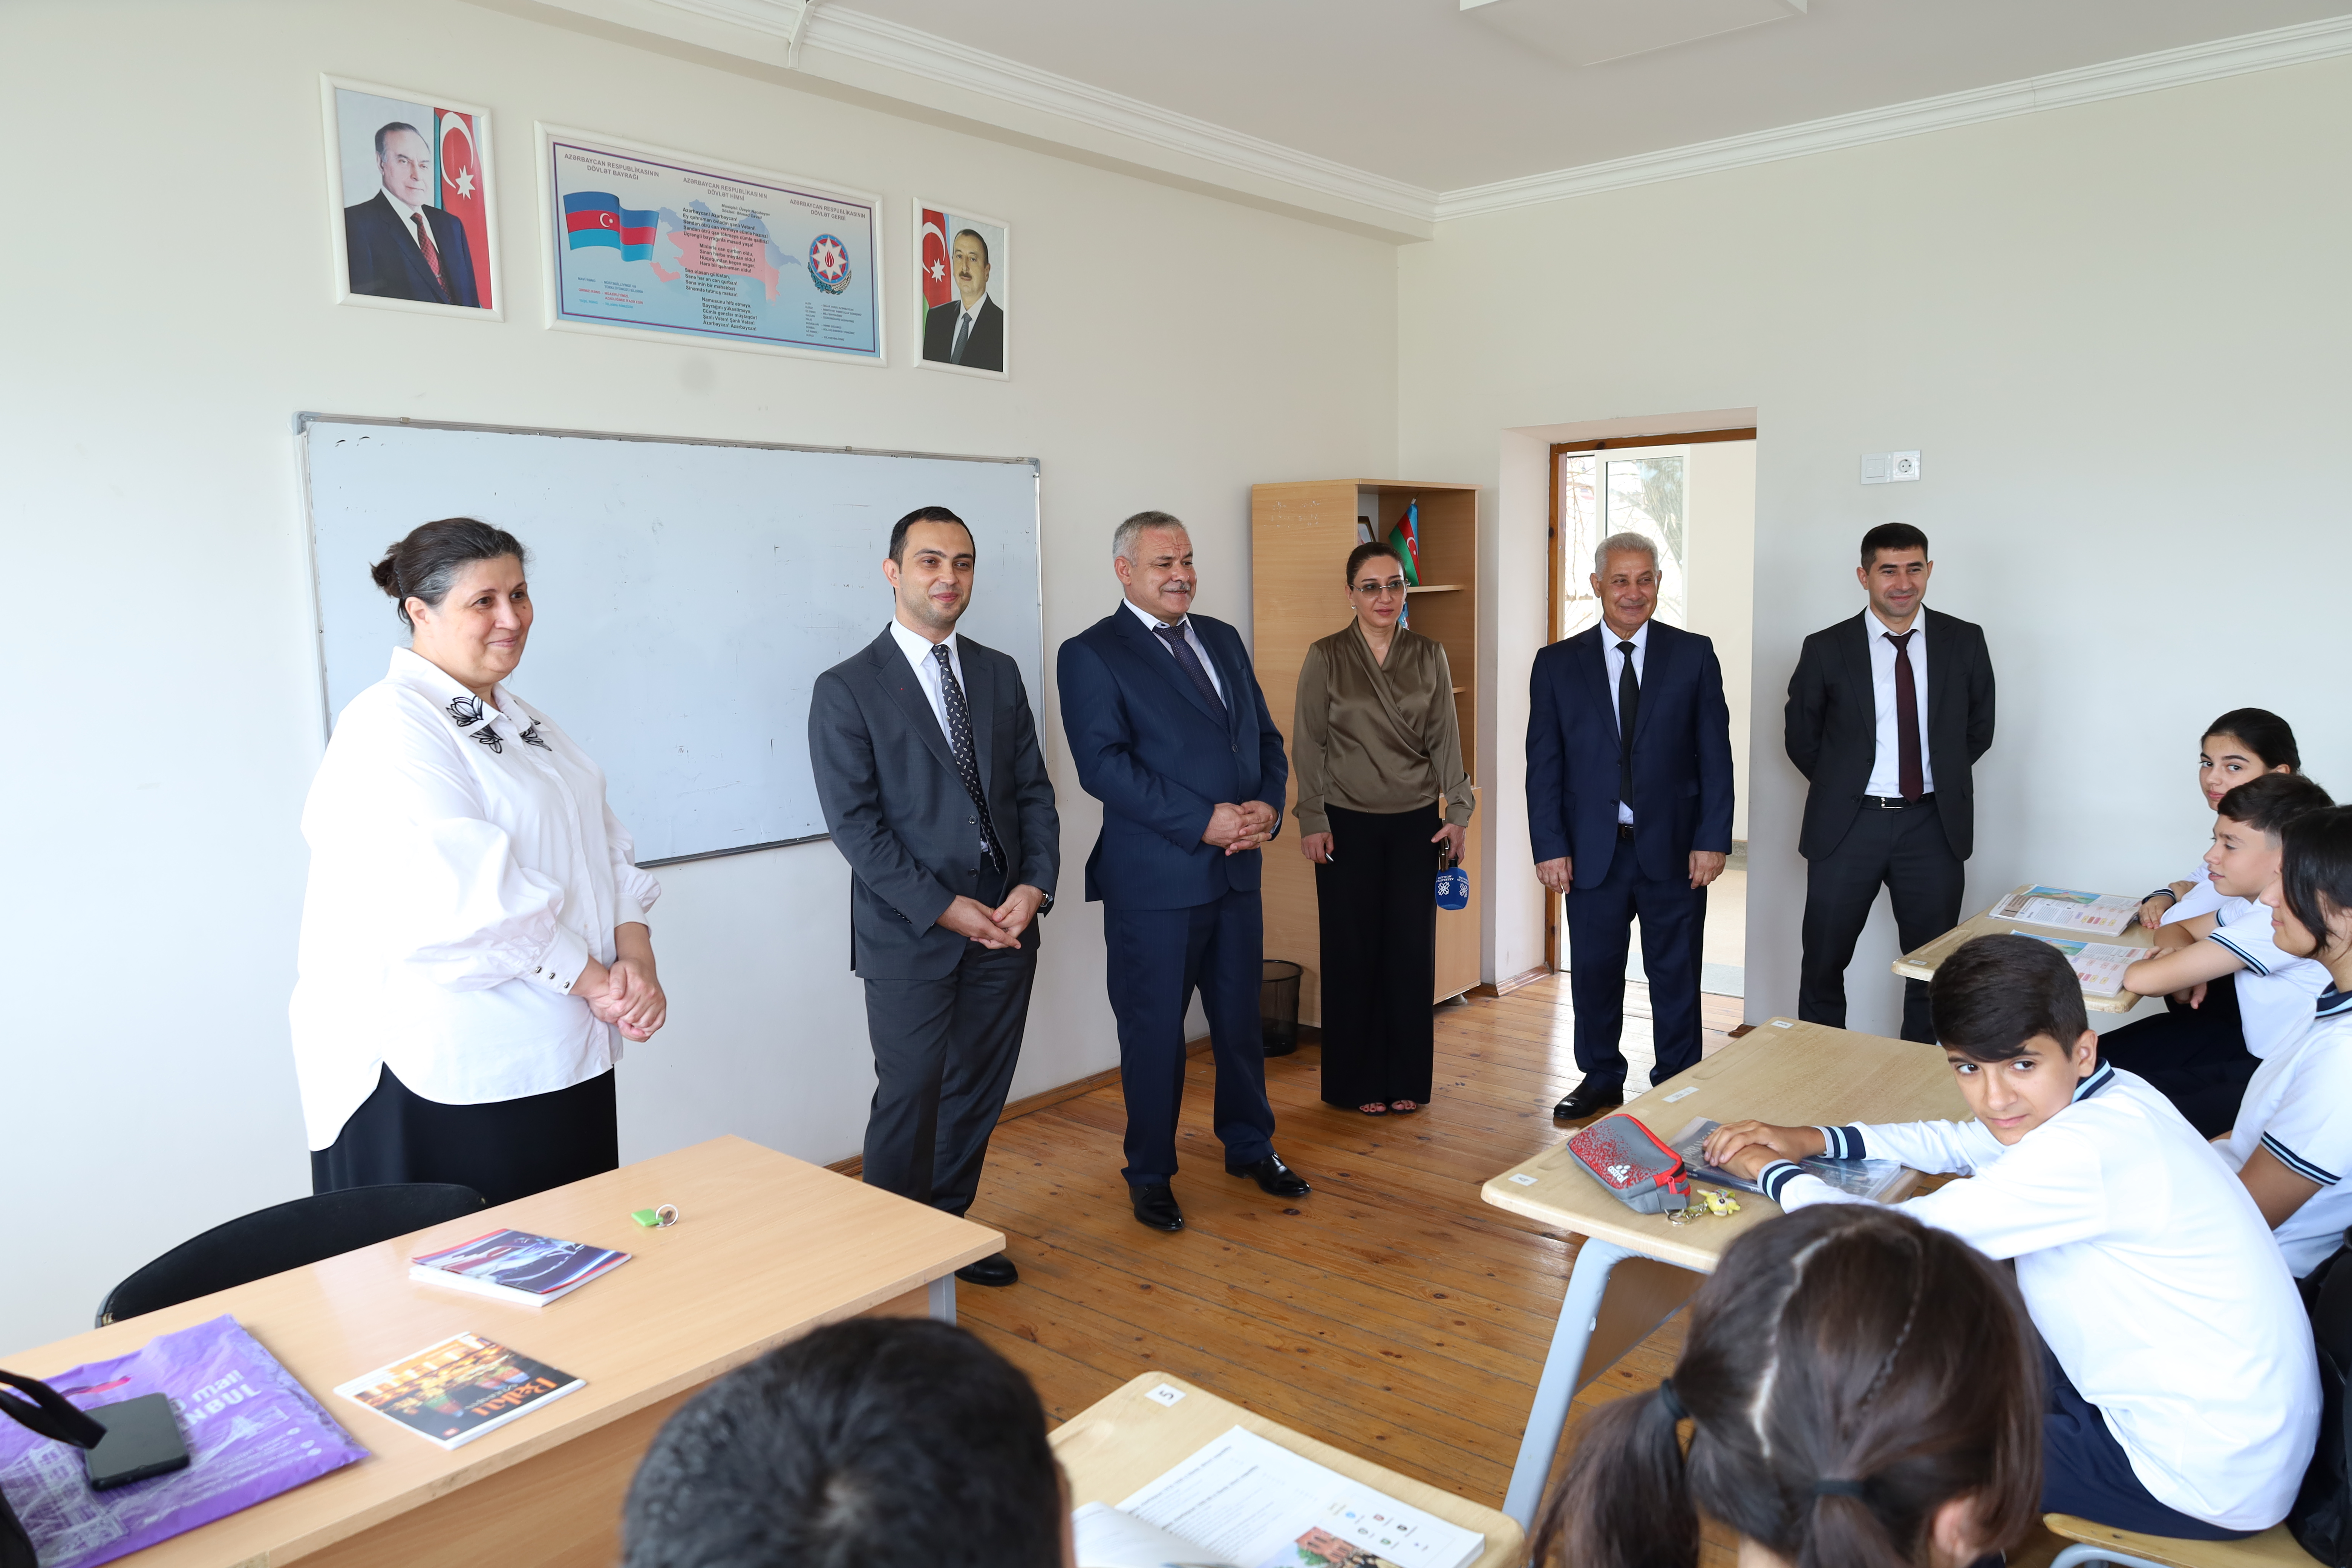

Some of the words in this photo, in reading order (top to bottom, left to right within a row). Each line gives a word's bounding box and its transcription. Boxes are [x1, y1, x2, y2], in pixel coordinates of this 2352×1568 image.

[565, 154, 605, 166] AZƏRBAYCAN
[608, 162, 659, 177] RESPUBLİKASININ
[587, 165, 611, 174] DÖVLƏT
[613, 170, 638, 180] BAYRAĞI
[683, 178, 720, 189] AZƏRBAYCAN
[721, 185, 767, 199] RESPUBLİKASININ
[707, 189, 729, 198] DÖVLƏT
[683, 207, 710, 216] Azərbaycan!
[790, 199, 822, 210] AZƏRBAYCAN
[824, 206, 865, 218] RESPUBLİKASININ
[683, 231, 702, 239] Üçrəngli
[1608, 1165, 1628, 1183] astral
[191, 1369, 245, 1403] mall
[1159, 1389, 1174, 1400] 5
[184, 1384, 262, 1426] NBUL
[472, 1377, 558, 1416] Baku
